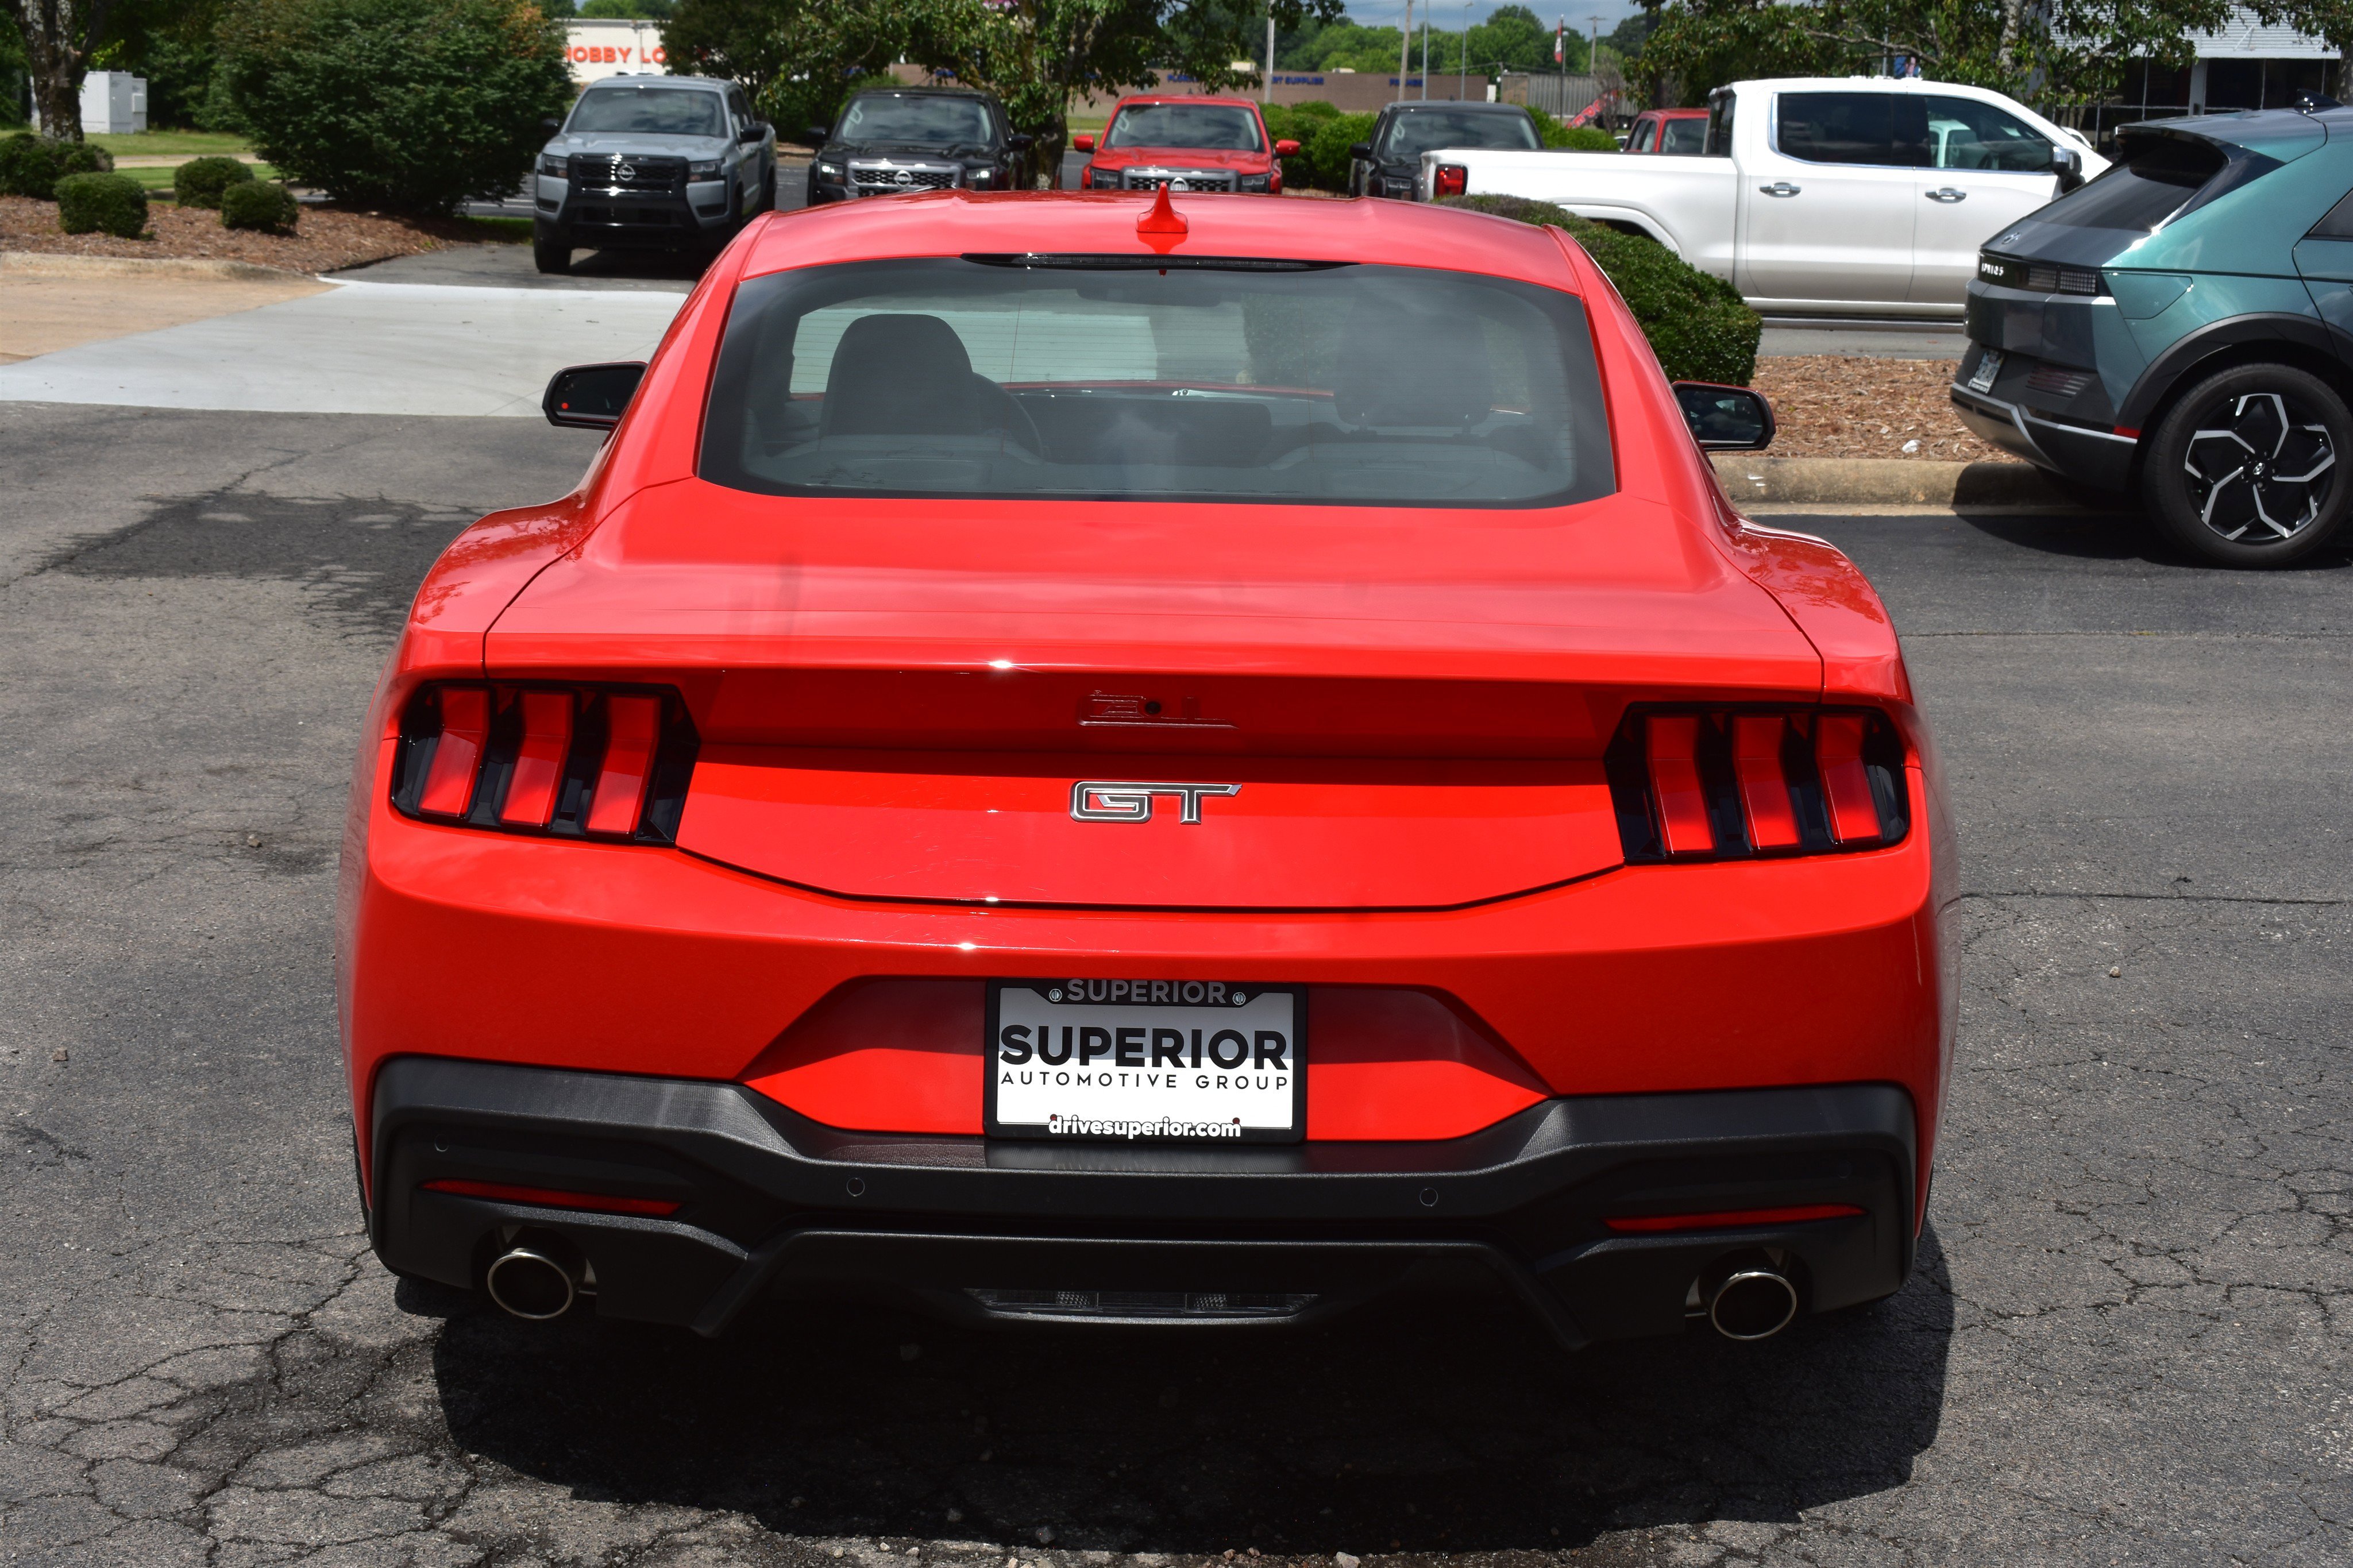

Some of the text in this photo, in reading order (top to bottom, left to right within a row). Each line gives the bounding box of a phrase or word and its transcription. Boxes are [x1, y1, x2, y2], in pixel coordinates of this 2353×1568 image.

[641, 47, 667, 63] LO
[1070, 780, 1243, 825] GT
[1067, 979, 1226, 1003] SUPERIOR
[1000, 1025, 1289, 1070] SUPERIOR
[1001, 1071, 1287, 1090] AUTOMOTIVE GROUP
[1048, 1115, 1241, 1140] drivesuperior.com
